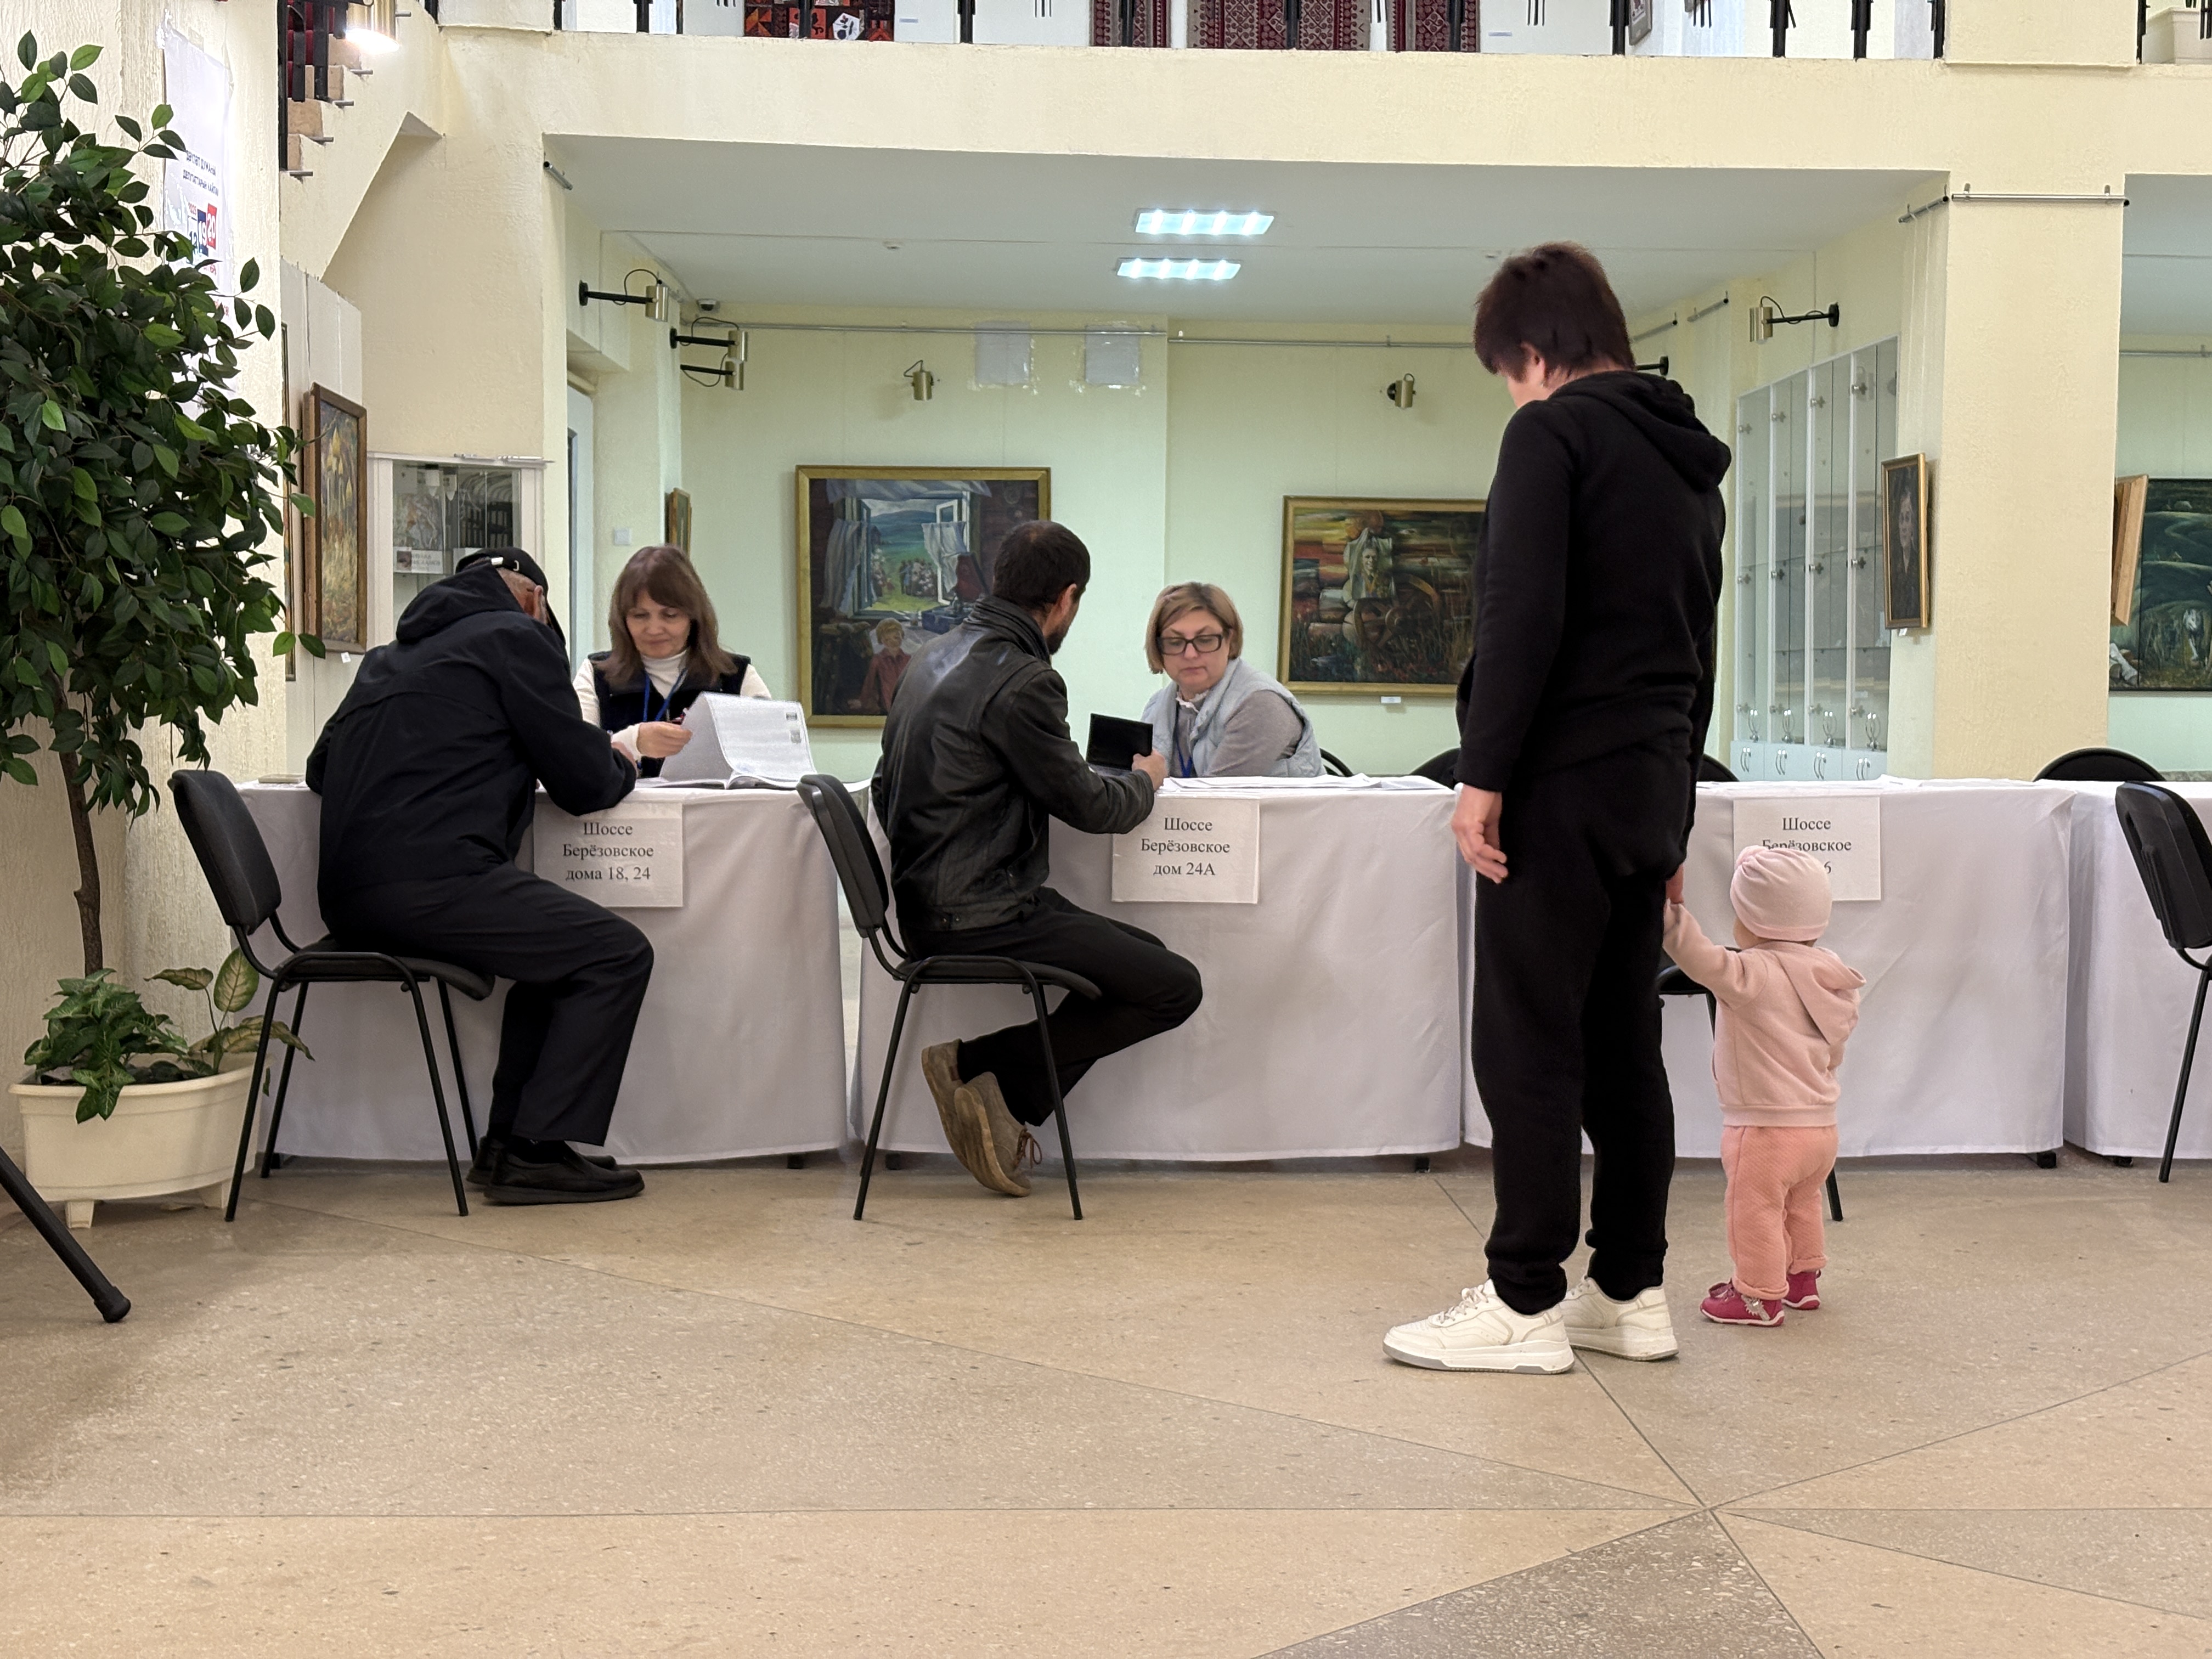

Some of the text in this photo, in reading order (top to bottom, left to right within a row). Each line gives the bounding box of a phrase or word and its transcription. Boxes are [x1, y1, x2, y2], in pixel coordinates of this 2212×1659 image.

[198, 221, 206, 246] 19
[207, 213, 216, 239] 20
[583, 822, 633, 836] Шоссе
[1164, 817, 1213, 831] Шоссе
[1782, 817, 1831, 830] Шоссе
[563, 844, 654, 860] Берёзовское
[1141, 838, 1231, 855] Берёзовское
[565, 866, 651, 881] дома 18, 24
[1153, 862, 1216, 876] дом 24А
